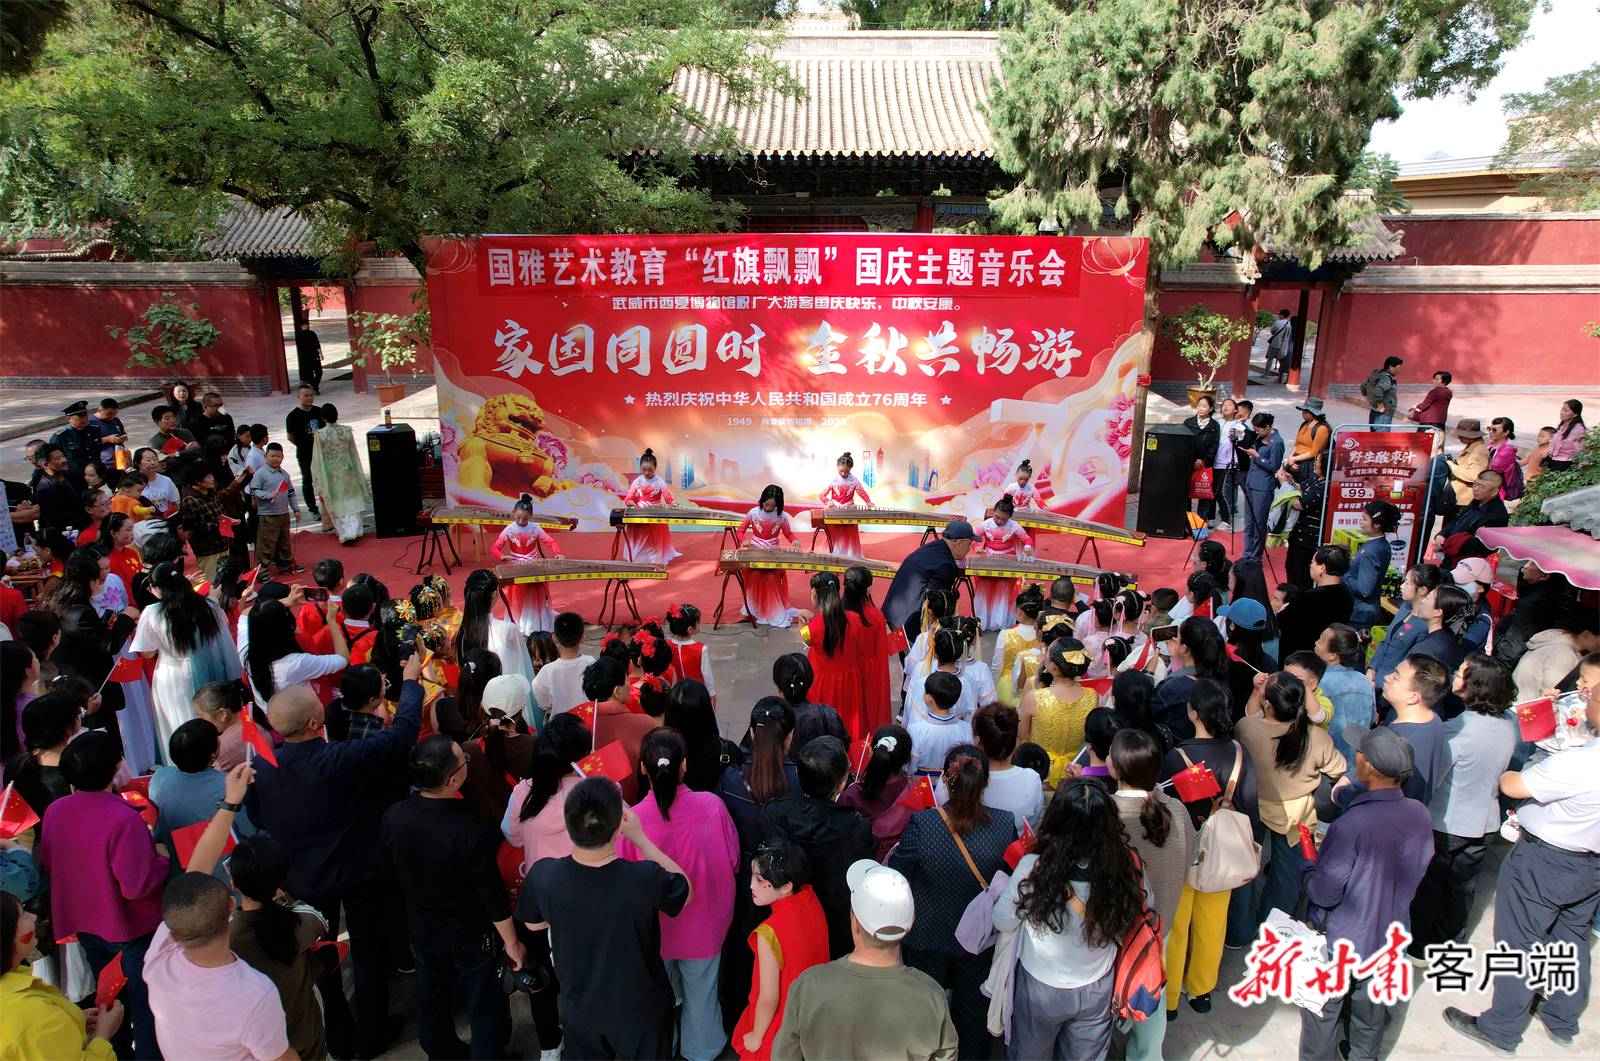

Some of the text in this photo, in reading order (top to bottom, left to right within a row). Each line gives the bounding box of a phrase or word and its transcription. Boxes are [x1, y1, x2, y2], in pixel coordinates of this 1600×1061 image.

[487, 246, 1066, 287] 国雅艺术教育 “红旗飘飘” 国庆主题音乐会
[492, 319, 1082, 379] 家国同圆时 金秋共畅游
[645, 392, 928, 407] 热烈庆祝中华人民共和国成立76周年
[727, 417, 752, 426] 1949
[821, 417, 847, 426] 2025
[1348, 450, 1417, 464] 野生酸枣汁
